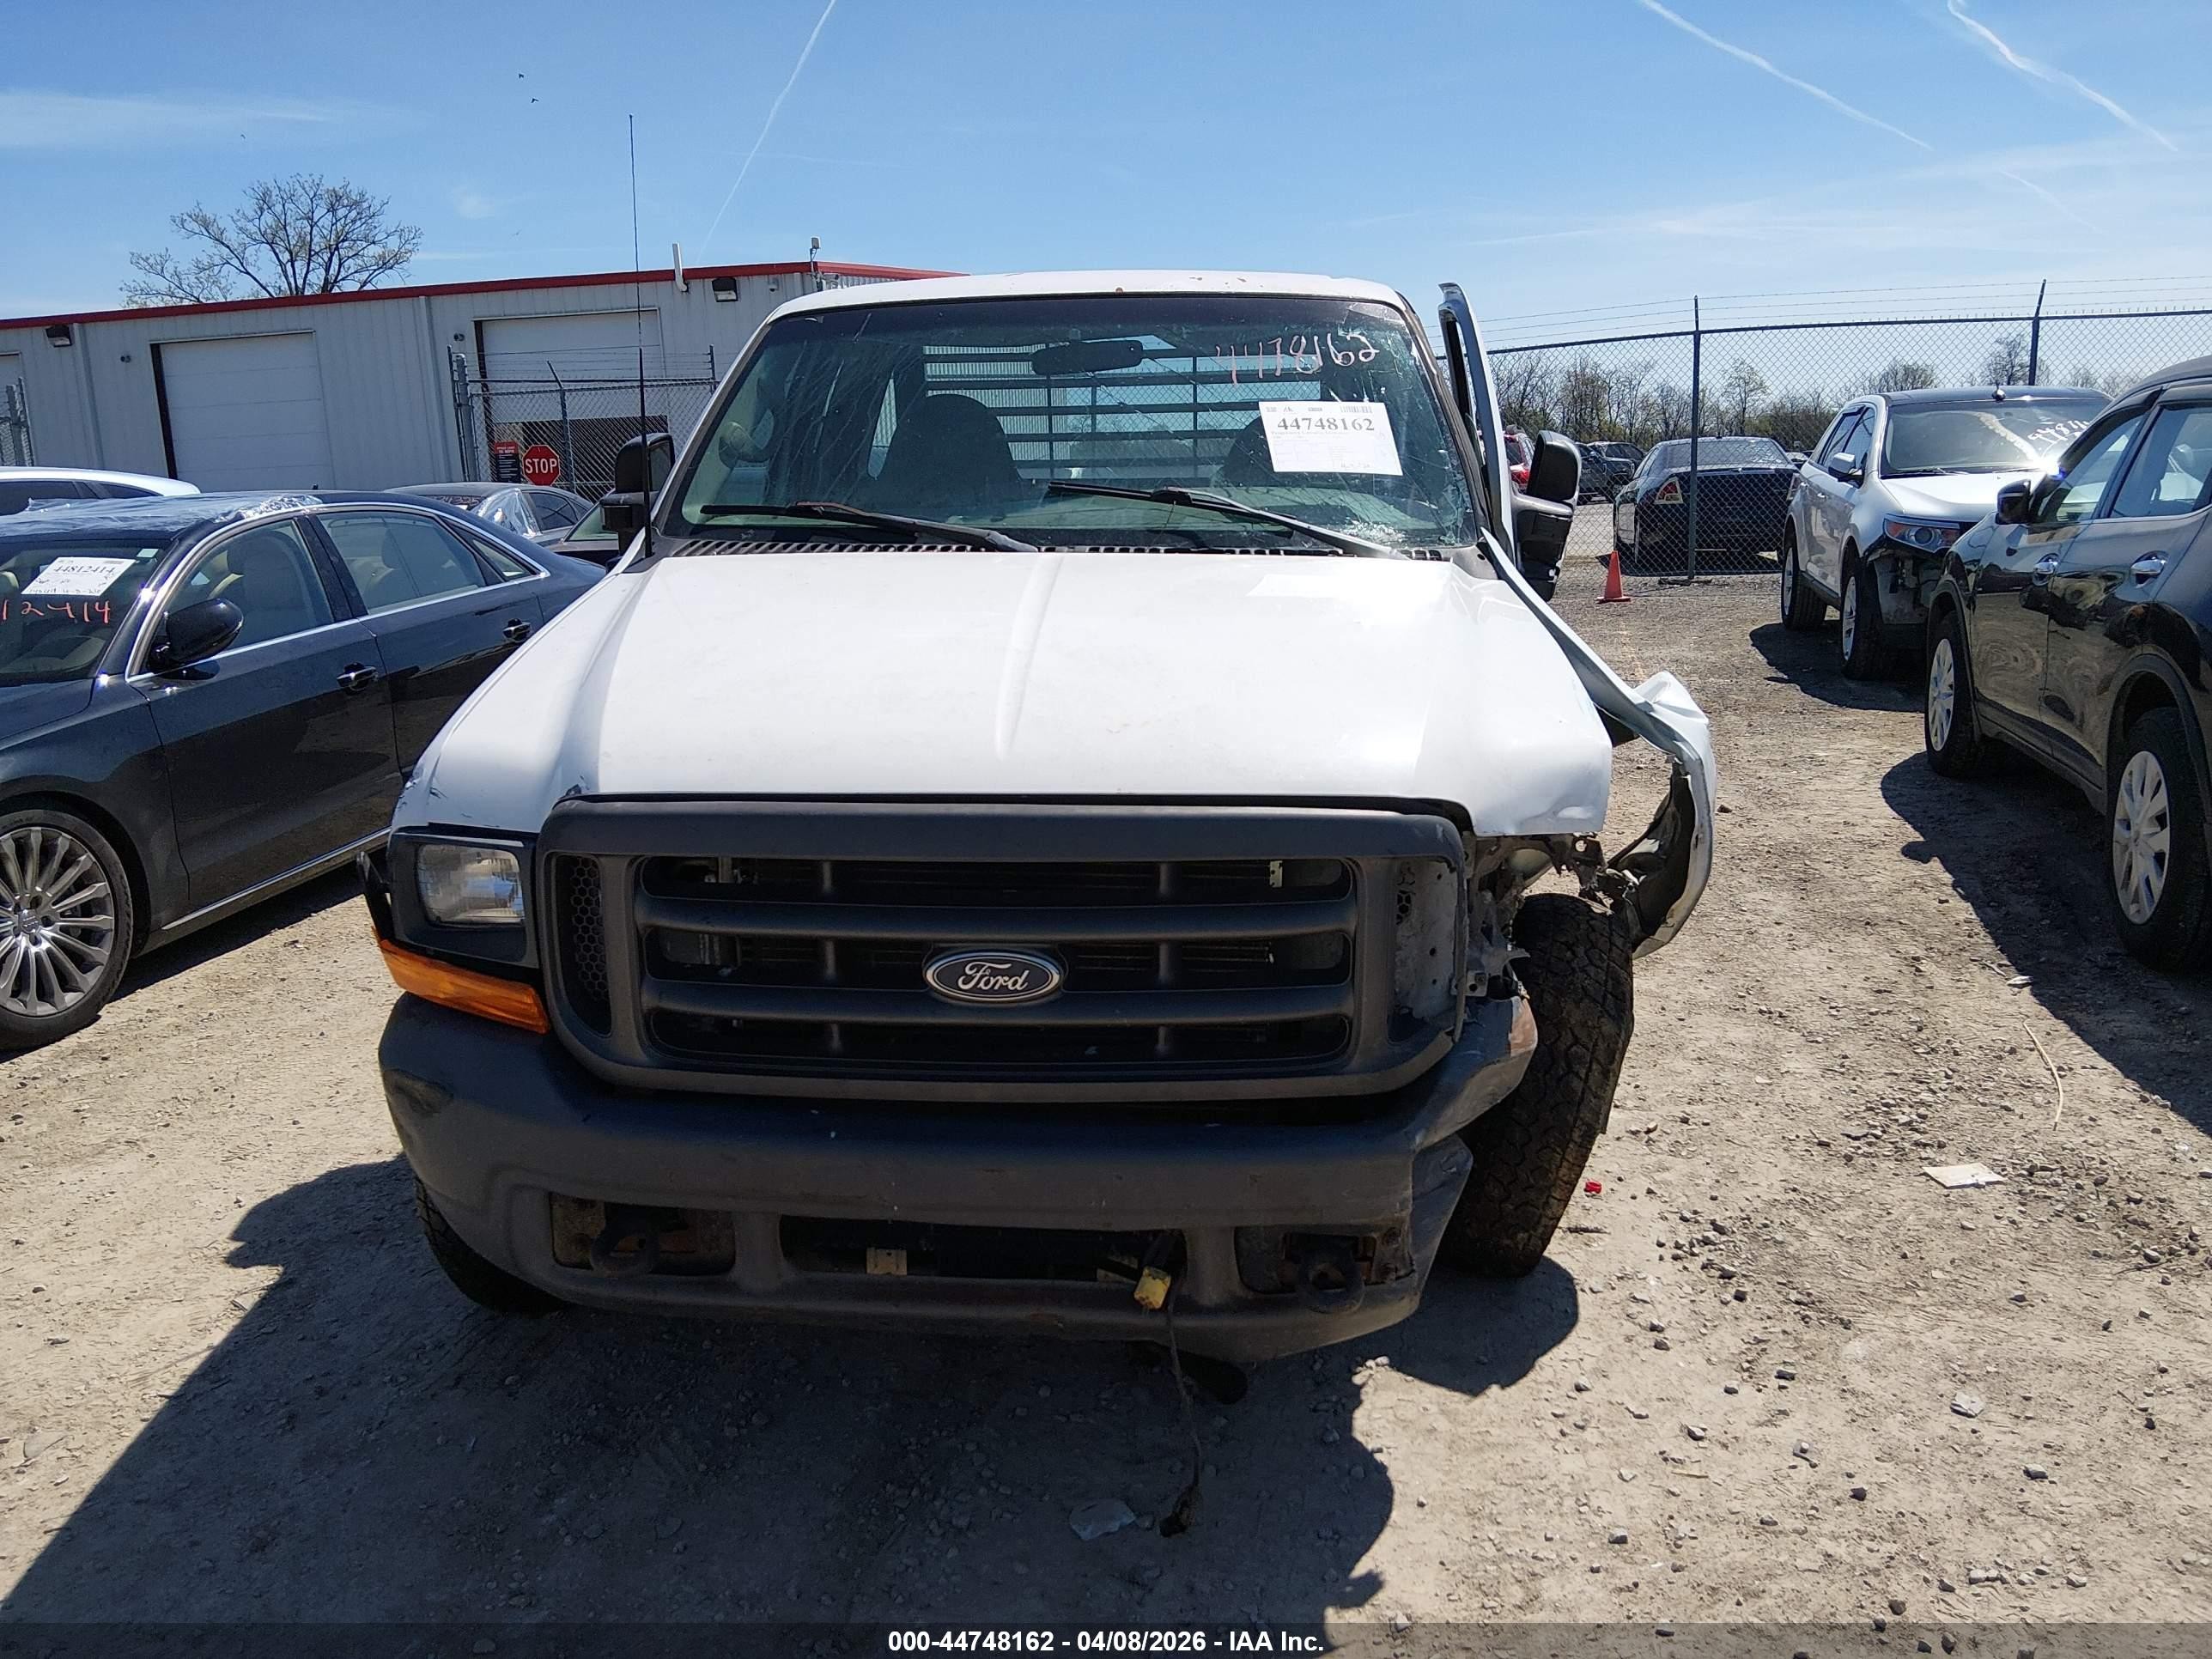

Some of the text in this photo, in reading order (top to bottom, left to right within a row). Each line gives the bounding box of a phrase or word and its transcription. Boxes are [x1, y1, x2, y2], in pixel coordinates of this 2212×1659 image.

[1277, 416, 1375, 431] 44748162
[525, 458, 557, 474] STOP
[53, 564, 116, 574] 44812414
[957, 961, 1030, 990] Ford
